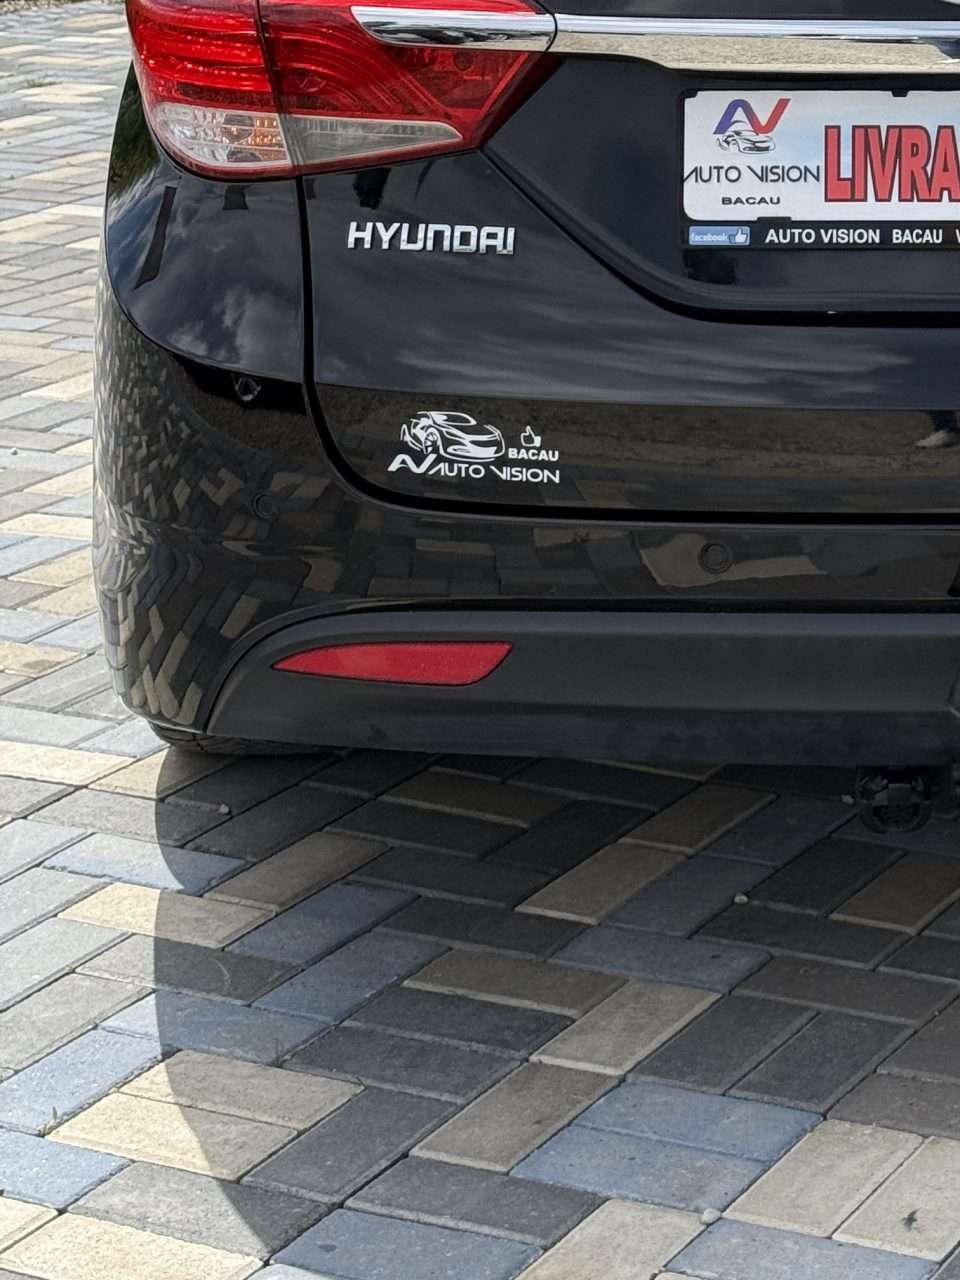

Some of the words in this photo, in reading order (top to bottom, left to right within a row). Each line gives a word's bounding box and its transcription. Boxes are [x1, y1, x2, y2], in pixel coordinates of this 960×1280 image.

[684, 166, 741, 183] AUTO
[747, 166, 820, 183] VISION
[721, 197, 781, 205] BACAU
[347, 221, 516, 255] HYUNDAI
[690, 233, 728, 242] facebook
[765, 229, 816, 244] AUTO
[820, 229, 880, 244] VISION
[892, 229, 943, 244] BACAU
[508, 448, 559, 461] BACAU
[428, 464, 485, 478] AUTO
[489, 465, 560, 484] VISION
